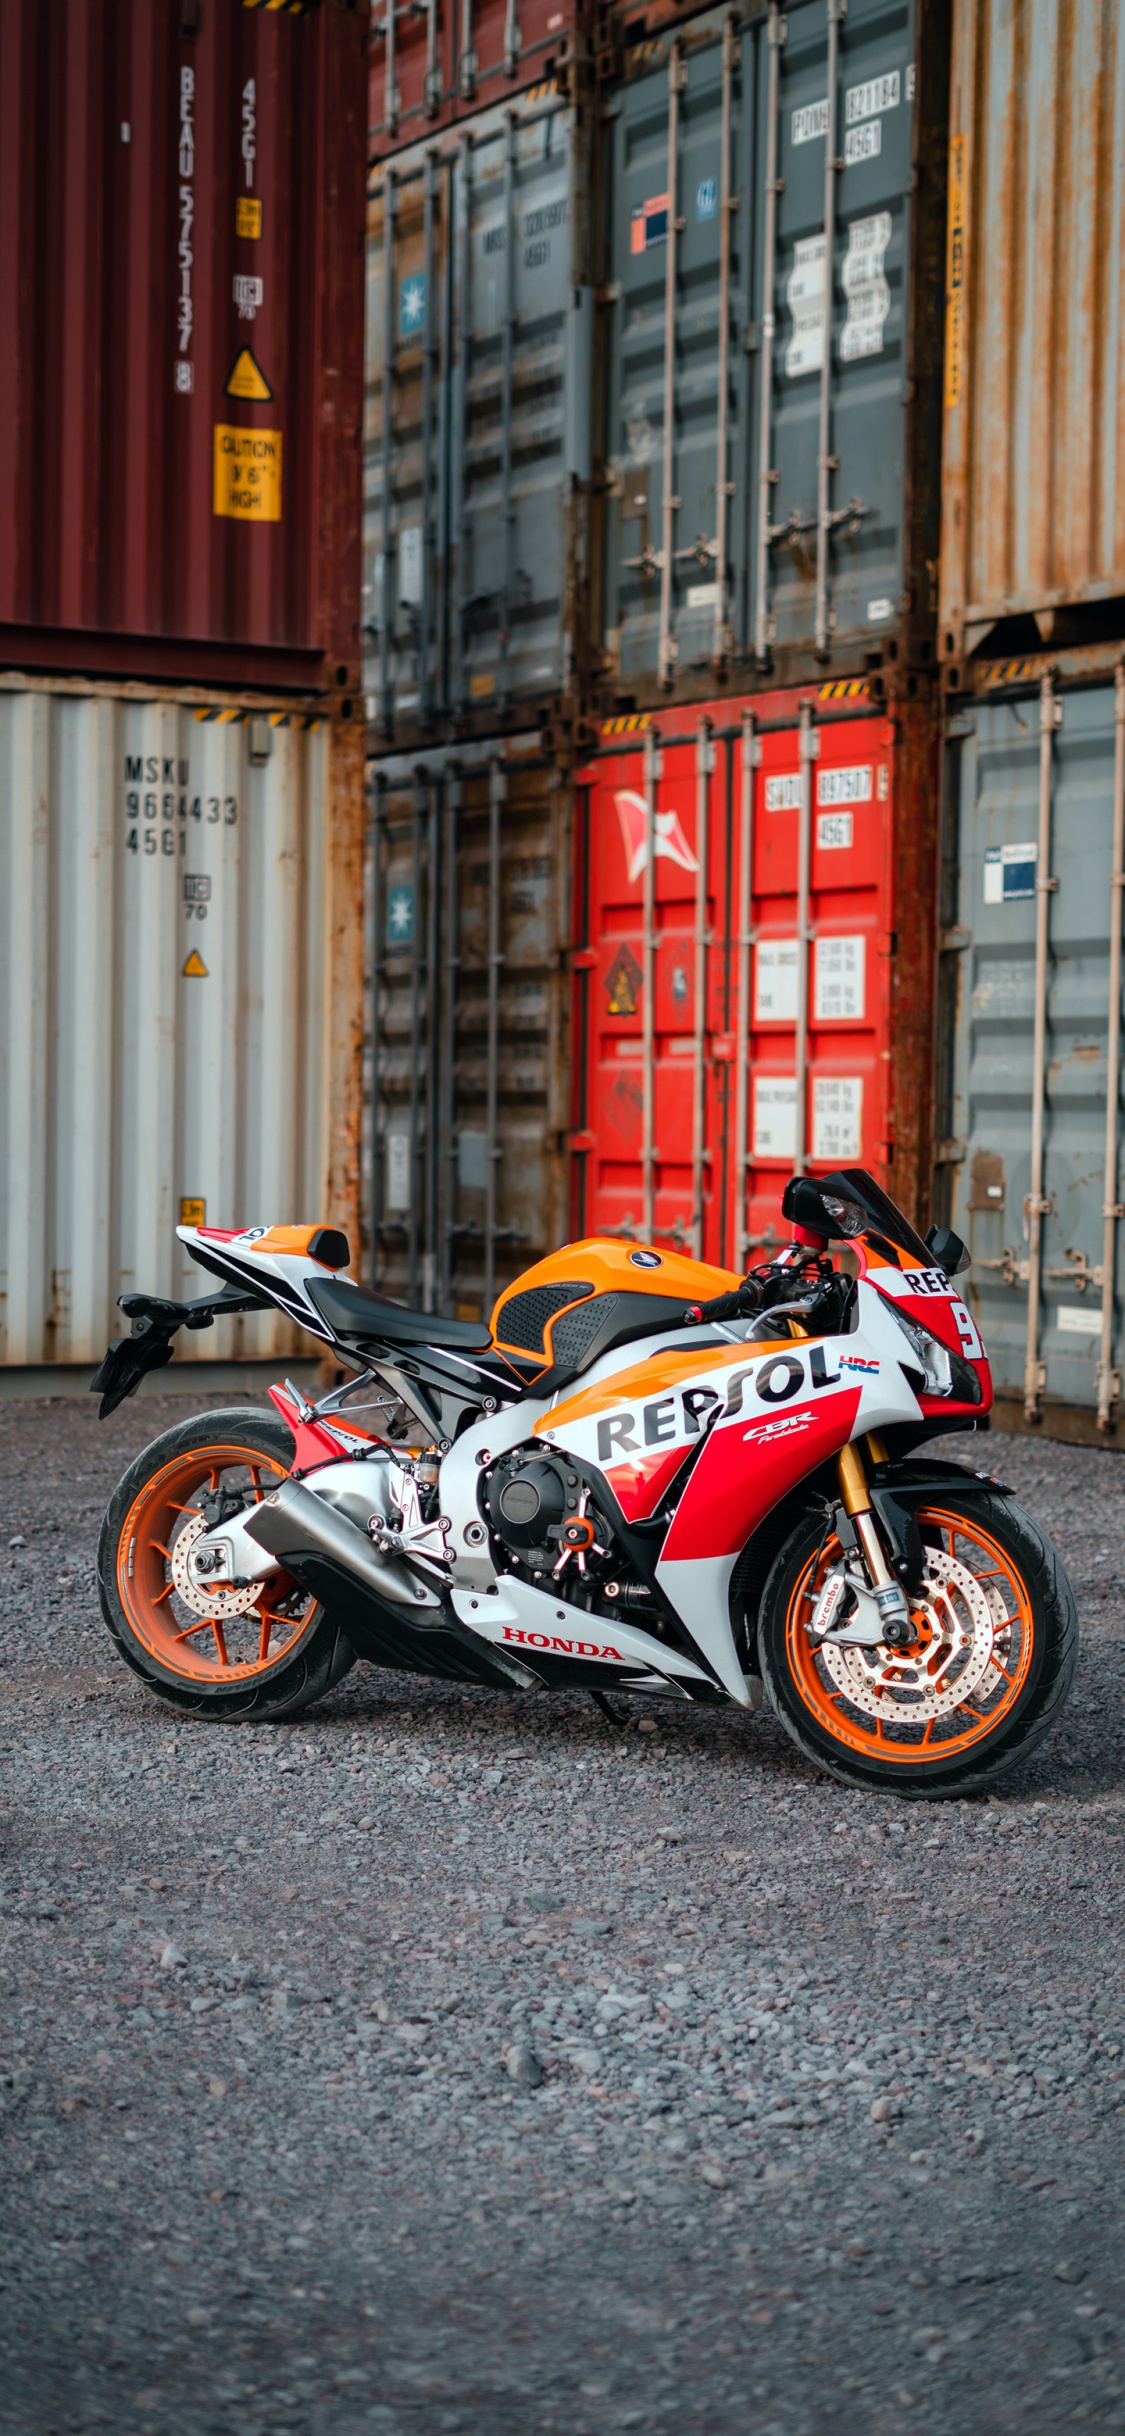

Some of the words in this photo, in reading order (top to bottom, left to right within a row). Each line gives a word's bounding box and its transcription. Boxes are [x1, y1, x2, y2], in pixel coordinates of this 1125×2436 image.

[179, 66, 195, 178] BEAU
[242, 78, 256, 188] 45G1
[177, 185, 194, 352] 575137
[221, 436, 276, 459] CAUTION
[125, 755, 189, 787] MSKU
[126, 790, 238, 826] 9664433
[125, 827, 186, 857] 45G1
[184, 903, 208, 920] 70
[903, 1271, 957, 1294] REP
[949, 1301, 989, 1360] 9
[838, 1355, 880, 1375] HRC
[597, 1346, 841, 1462] REPSOL
[742, 1411, 820, 1442] CBR
[757, 1424, 810, 1445] Fireblade
[817, 1583, 839, 1626] brembo
[502, 1626, 626, 1661] HONDA
